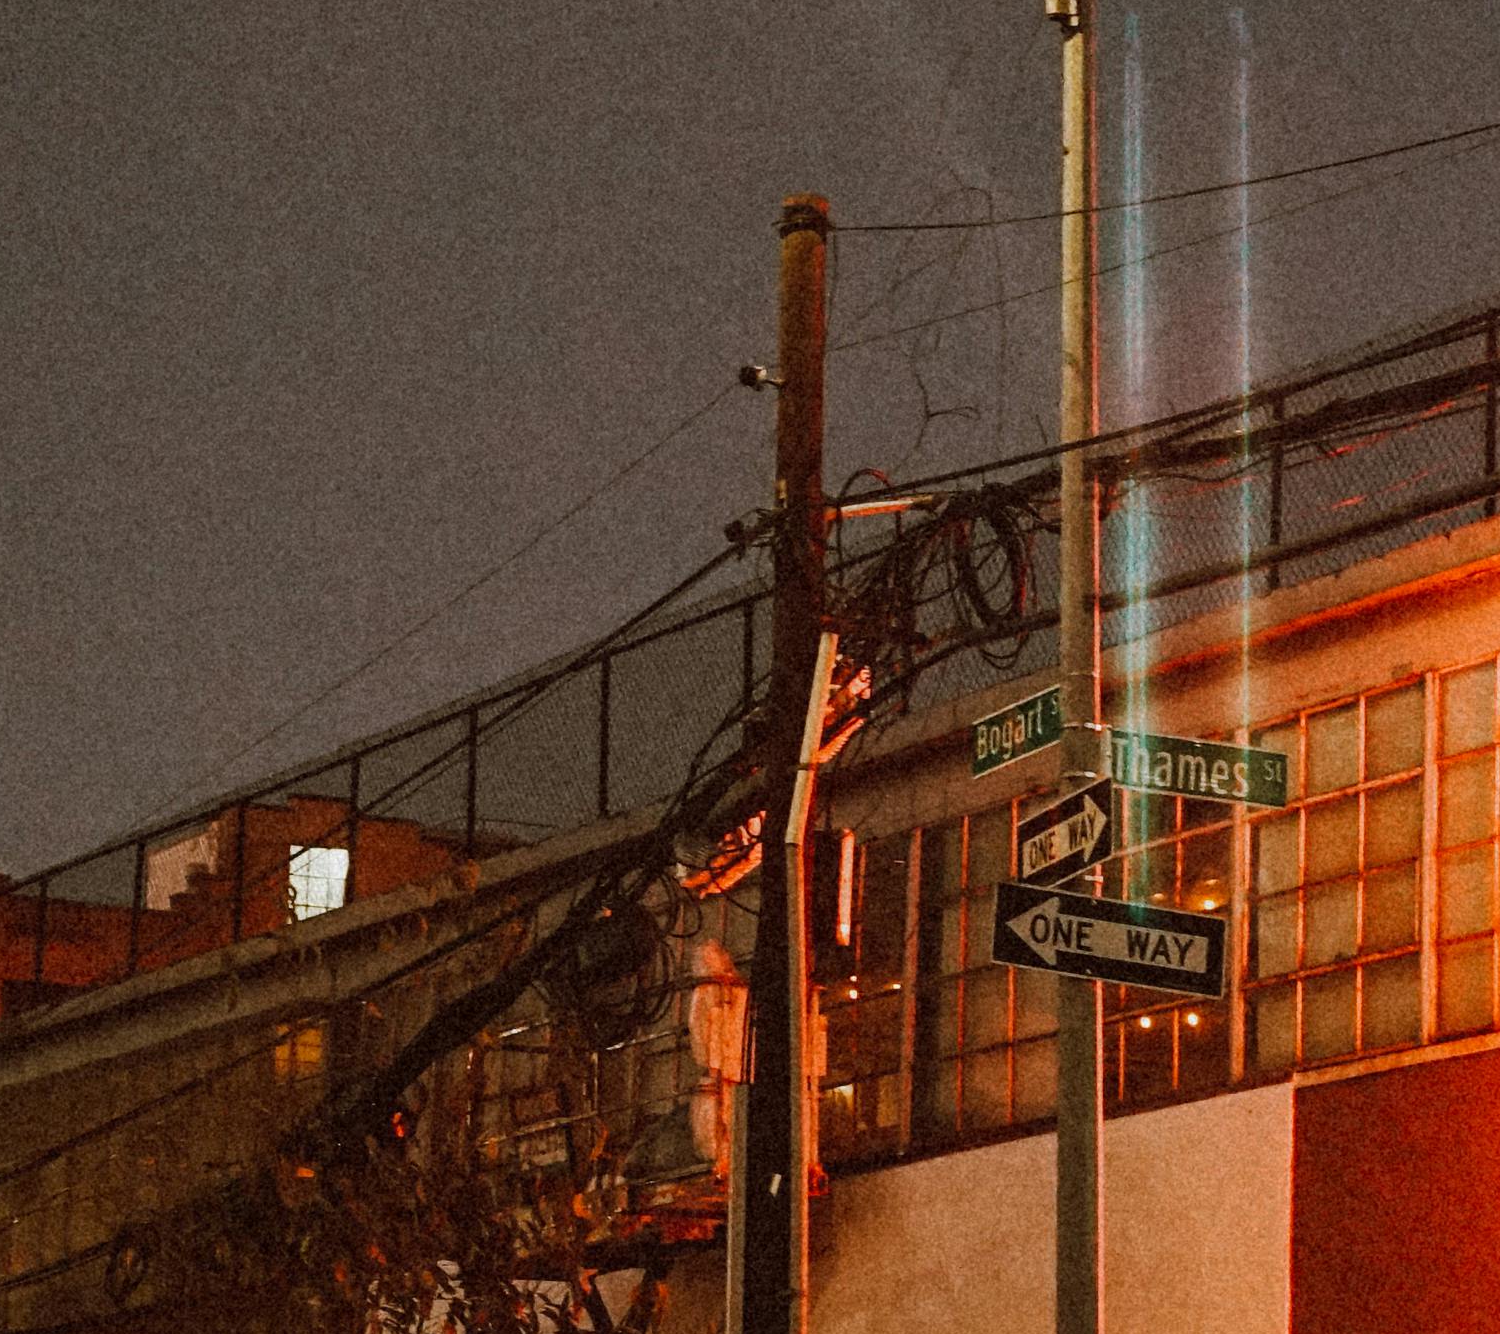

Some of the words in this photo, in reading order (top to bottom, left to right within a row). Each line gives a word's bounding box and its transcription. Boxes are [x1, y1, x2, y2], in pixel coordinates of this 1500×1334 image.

[977, 698, 1043, 760] Bogart
[1111, 736, 1249, 798] Thames
[1263, 759, 1283, 783] St
[1029, 830, 1057, 869] ONE
[1067, 809, 1097, 852] WAY
[1029, 914, 1094, 953] ONE
[1126, 929, 1195, 967] WAY
